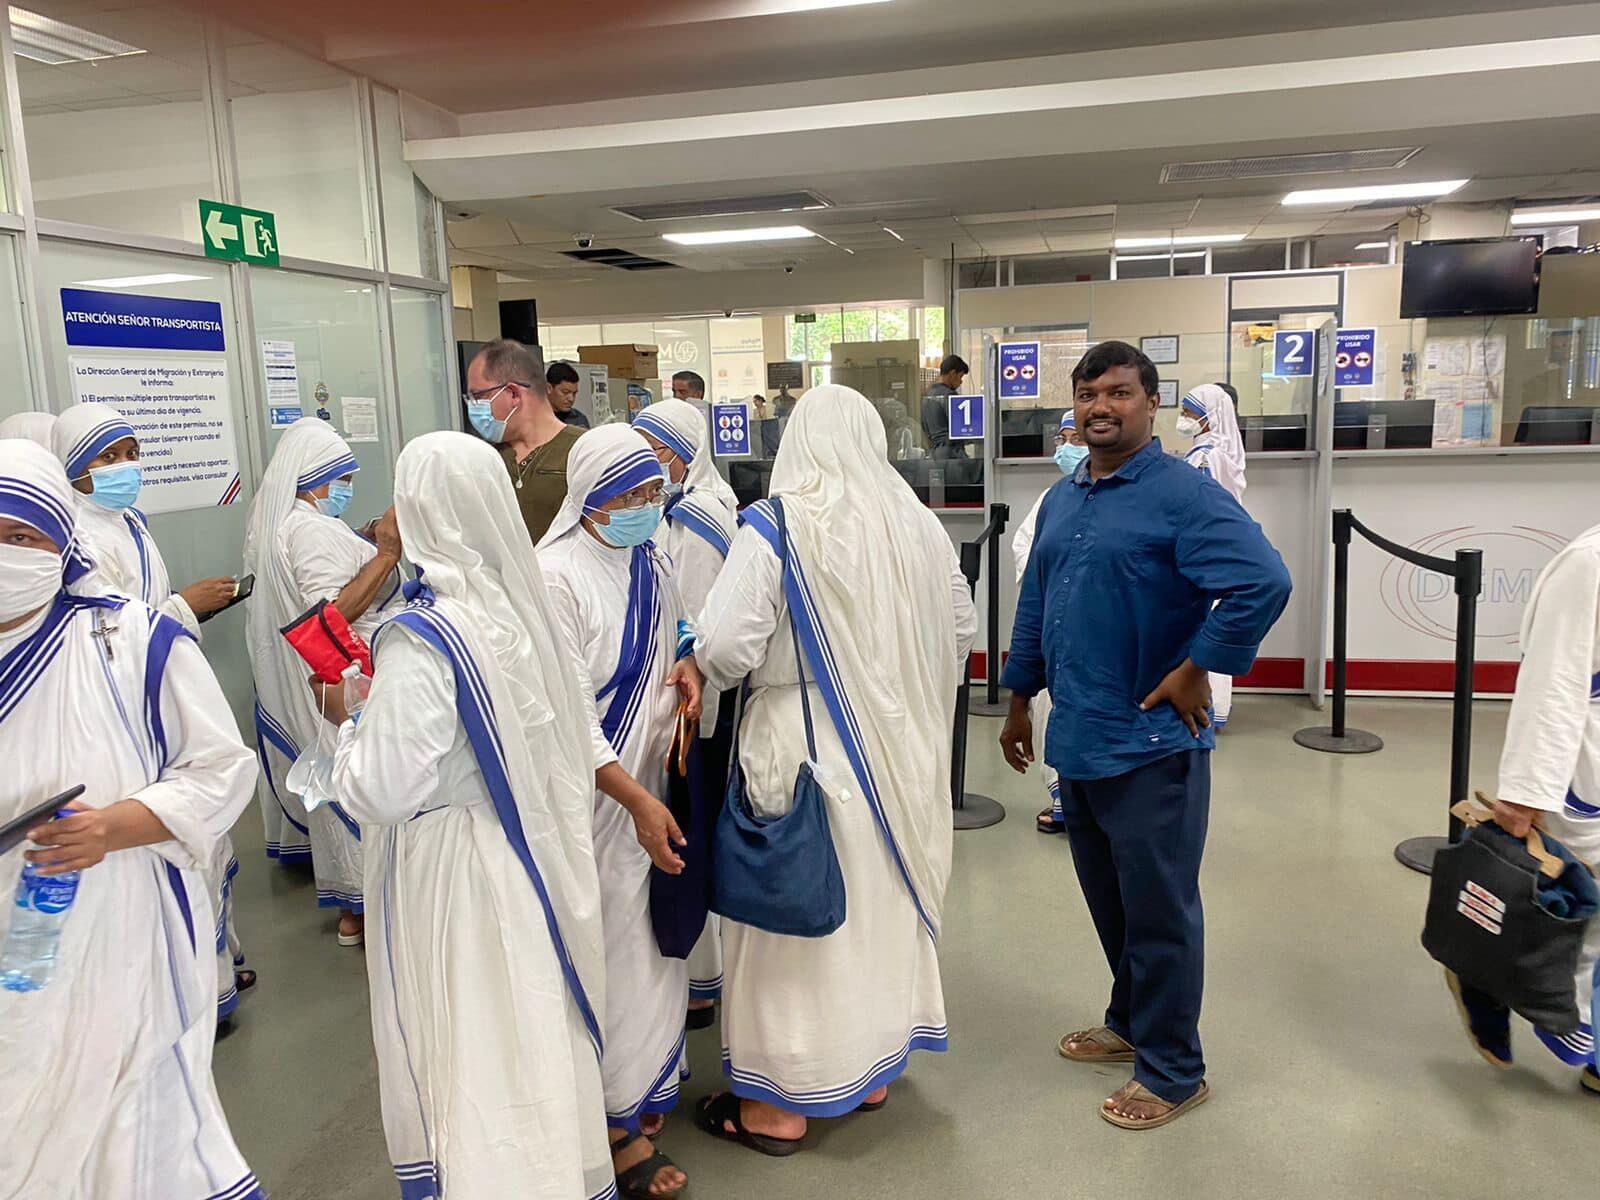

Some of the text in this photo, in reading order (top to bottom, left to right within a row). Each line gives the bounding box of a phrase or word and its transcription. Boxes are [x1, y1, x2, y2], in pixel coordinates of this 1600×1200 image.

[65, 311, 222, 331] ATENCIÓN SEÑOR TRANSPORTISTA
[1283, 334, 1304, 363] 2
[76, 367, 86, 376] La
[120, 368, 147, 376] General
[147, 368, 156, 376] de
[187, 370, 192, 378] y
[81, 394, 89, 403] 1)
[88, 394, 96, 402] El
[96, 394, 125, 404] permiso
[152, 395, 169, 403] para
[169, 394, 209, 404] transportista
[167, 407, 176, 415] de
[958, 399, 971, 426] 1
[159, 421, 168, 430] de
[168, 421, 182, 429] este
[139, 435, 161, 445] nsular
[161, 434, 188, 444] (siempre
[193, 433, 215, 441] cuando
[215, 432, 221, 440] el
[146, 447, 173, 458] vencido)
[143, 464, 162, 473] vence
[178, 460, 206, 470] necesario
[142, 477, 160, 487] otros
[191, 473, 204, 481] visa
[204, 471, 228, 480] consular
